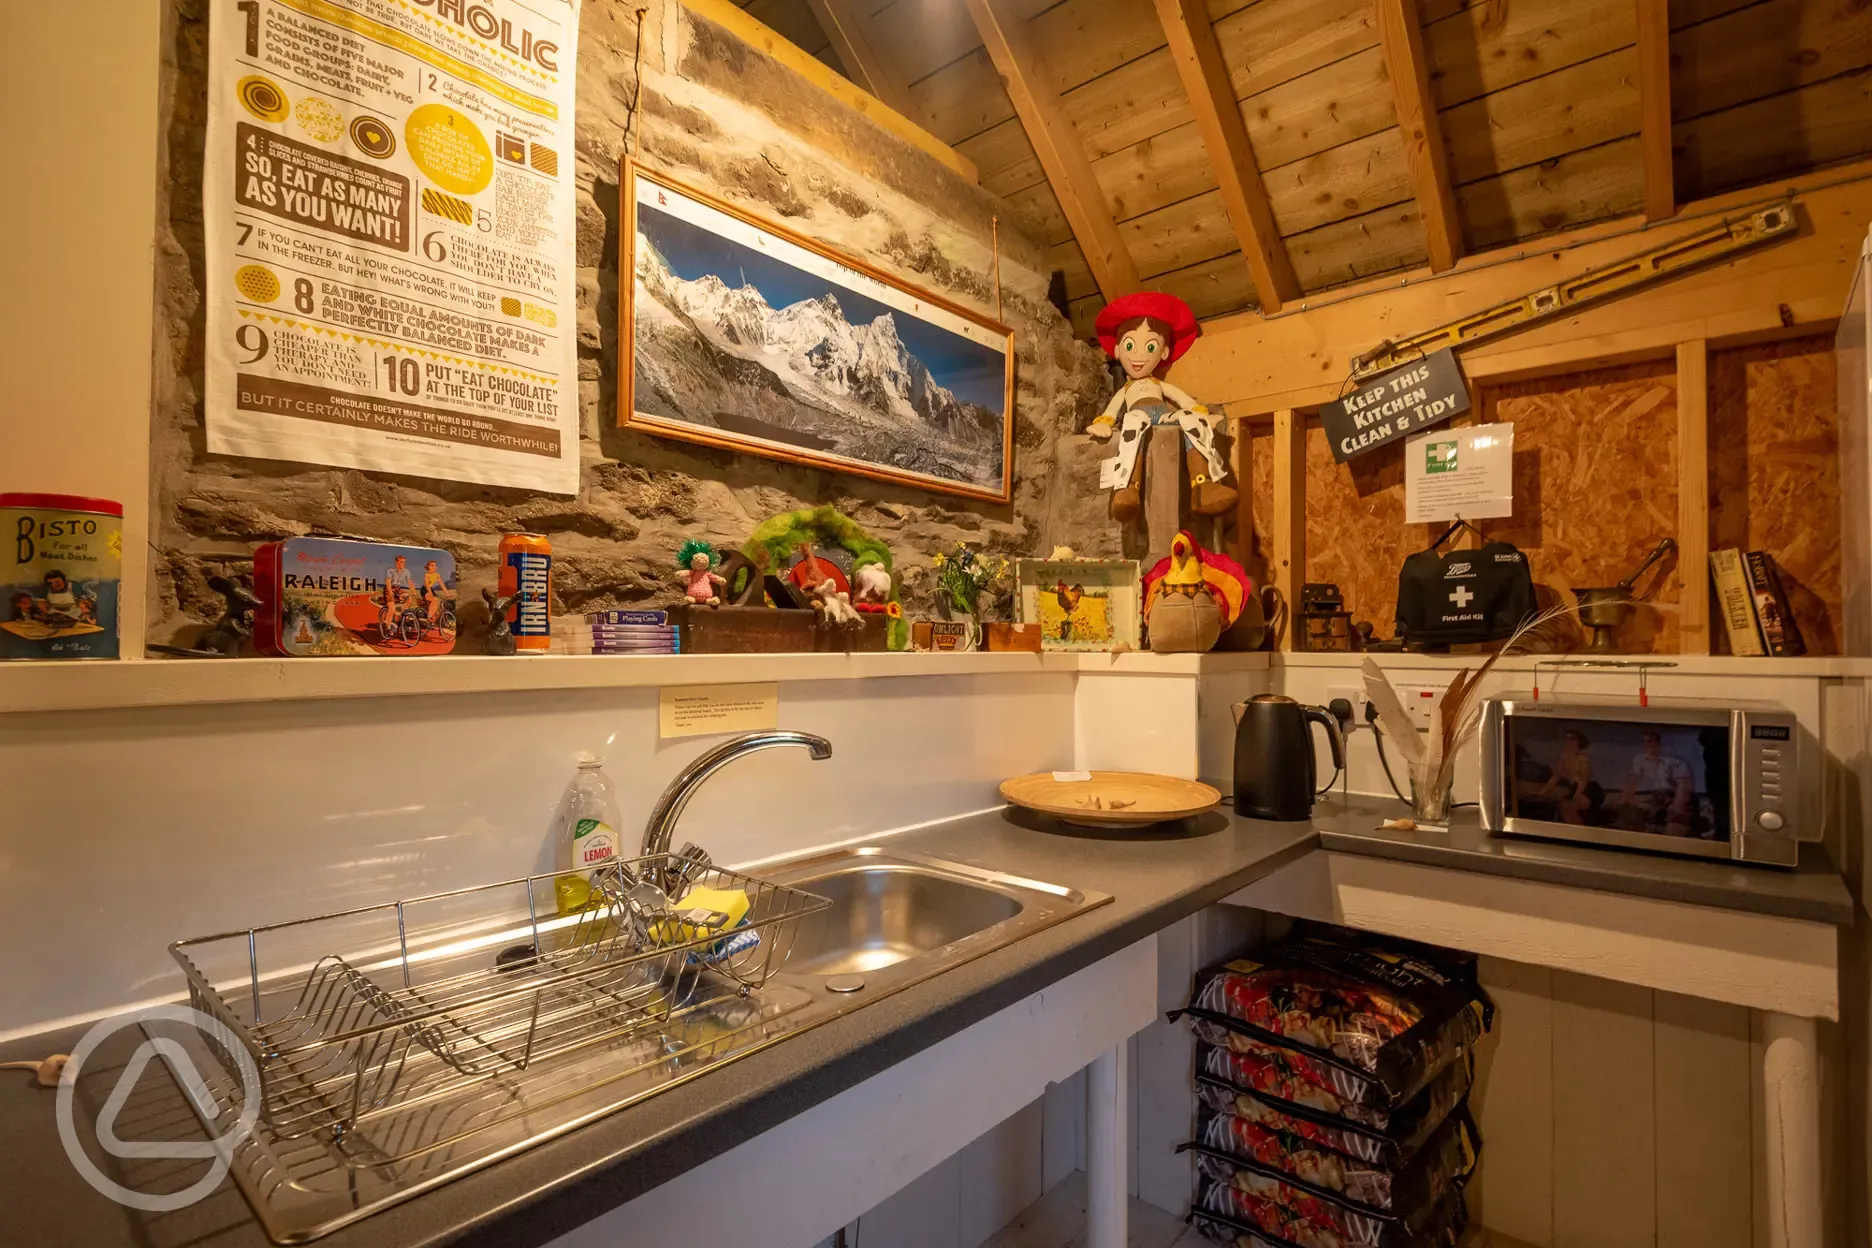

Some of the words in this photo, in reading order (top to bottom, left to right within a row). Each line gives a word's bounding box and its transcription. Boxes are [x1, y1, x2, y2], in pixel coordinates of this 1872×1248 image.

[266, 19, 320, 47] CONSISTS
[323, 42, 339, 55] OF
[340, 47, 364, 62] FIVE
[366, 56, 404, 79] MAJOR
[267, 8, 275, 18] A
[277, 11, 339, 41] BALANCED
[342, 35, 366, 52] DIET
[412, 0, 559, 72] HOLIC
[265, 43, 313, 68] GRAINS,
[316, 62, 352, 82] MEATS,
[356, 76, 383, 93] FRUIT
[393, 91, 414, 104] VEG
[265, 54, 290, 70] AND
[294, 65, 365, 97] CHOCOLATE.
[266, 30, 300, 51] FOOD
[303, 46, 354, 71] GROUPS:
[356, 64, 390, 85] DAIRY,
[428, 73, 437, 92] 2
[443, 81, 478, 103] Chocolate
[493, 106, 510, 124] many
[443, 92, 464, 108] which
[465, 103, 482, 116] make
[448, 115, 454, 127] 3
[247, 134, 256, 150] 4
[269, 140, 302, 158] CHOCOLATE
[303, 151, 329, 167] COVERED
[382, 177, 403, 189] ORANGE
[269, 147, 290, 162] SLICES
[292, 156, 306, 167] AND
[307, 161, 354, 182] STRAWBERRIES
[355, 174, 375, 188] COUNT
[376, 182, 385, 192] AS
[385, 186, 403, 197] FRUIT
[245, 151, 277, 182] SO,
[282, 163, 317, 192] EAT
[321, 177, 346, 201] AS
[350, 185, 402, 218] MANY
[245, 176, 277, 207] AS
[280, 186, 327, 221] YOU
[331, 201, 400, 243] WANT!
[477, 209, 492, 233] 5
[236, 221, 253, 246] 7
[423, 231, 447, 263] 6
[258, 228, 267, 238] IF
[269, 232, 290, 245] YOU
[293, 240, 324, 254] CAN'T
[326, 248, 342, 260] EAT
[345, 254, 360, 265] ALL
[363, 258, 389, 272] YOUR
[450, 282, 457, 291] IT
[458, 285, 475, 297] WILL
[477, 291, 496, 301] KEEP
[451, 235, 509, 259] CHOCOLATE
[525, 257, 555, 272] ALWAYS
[451, 243, 484, 259] THERE
[486, 254, 506, 266] FOR
[509, 259, 531, 271] YOU
[533, 267, 556, 281] WHEN
[451, 251, 470, 262] YOU
[473, 259, 504, 274] DON'T
[508, 269, 533, 281] HAVE
[258, 240, 269, 251] IN
[272, 244, 289, 257] THE
[292, 251, 335, 270] FREEZER.
[338, 263, 354, 274] BUT
[357, 268, 377, 280] HEY!
[380, 273, 411, 289] WHAT'S
[414, 282, 448, 299] WRONG
[450, 293, 469, 305] WITH
[471, 300, 495, 312] YOU?!
[450, 260, 504, 282] SHOULDER
[523, 281, 540, 291] CRY
[294, 278, 314, 314] 8
[321, 282, 377, 305] EATING
[380, 300, 426, 319] EQUAL
[429, 310, 493, 334] AMOUNTS
[496, 326, 513, 338] OF
[516, 331, 546, 348] DARK
[235, 324, 269, 364] 9
[274, 330, 342, 351] CHOCOLATE
[347, 346, 356, 354] IS
[321, 296, 354, 312] AND
[357, 303, 404, 325] WHITE
[407, 313, 487, 344] CHOCOLATE
[490, 334, 530, 354] MAKES
[531, 345, 539, 356] A
[322, 307, 400, 334] PERFECTLY
[402, 326, 472, 351] BALANCED
[475, 344, 507, 359] DIET.
[274, 339, 328, 356] CHEAPER
[333, 351, 361, 363] THAN
[274, 347, 328, 363] THERAPY
[333, 359, 354, 369] AND
[274, 354, 295, 365] YOU
[302, 360, 334, 372] DON'T
[339, 367, 366, 379] NEED
[275, 363, 289, 371] AN
[293, 366, 371, 388] APPOINTMENT!
[383, 355, 420, 397] 10
[426, 363, 452, 380] PUT
[1343, 385, 1385, 415] KEEP
[1389, 365, 1430, 393] THIS
[330, 396, 371, 411] CHOCOLATE
[373, 404, 401, 415] DOESN'T
[403, 410, 421, 419] MAKE
[423, 413, 435, 421] THE
[437, 414, 460, 425] WORLD
[462, 419, 471, 427] GO
[426, 380, 440, 393] AT
[444, 383, 465, 398] THE
[469, 388, 490, 403] TOP
[494, 393, 508, 406] OF
[510, 396, 534, 413] YOUR
[537, 403, 558, 417] LIST
[1353, 387, 1427, 430] KITCHEN
[241, 391, 275, 407] BUT
[278, 398, 292, 409] IT
[295, 401, 370, 422] CERTAINLY
[374, 413, 418, 430] MAKES
[421, 421, 446, 434] THE
[450, 426, 477, 439] RIDE
[480, 431, 558, 452] WORTHWHILE!
[1340, 422, 1392, 455] CLEAN
[1397, 415, 1410, 431] &
[1415, 393, 1457, 423] TIDY
[16, 516, 97, 566] BISTO
[67, 551, 98, 562] Dishes
[285, 573, 377, 592] RALEIGH
[622, 615, 642, 623] Playing
[584, 846, 613, 862] LEMON
